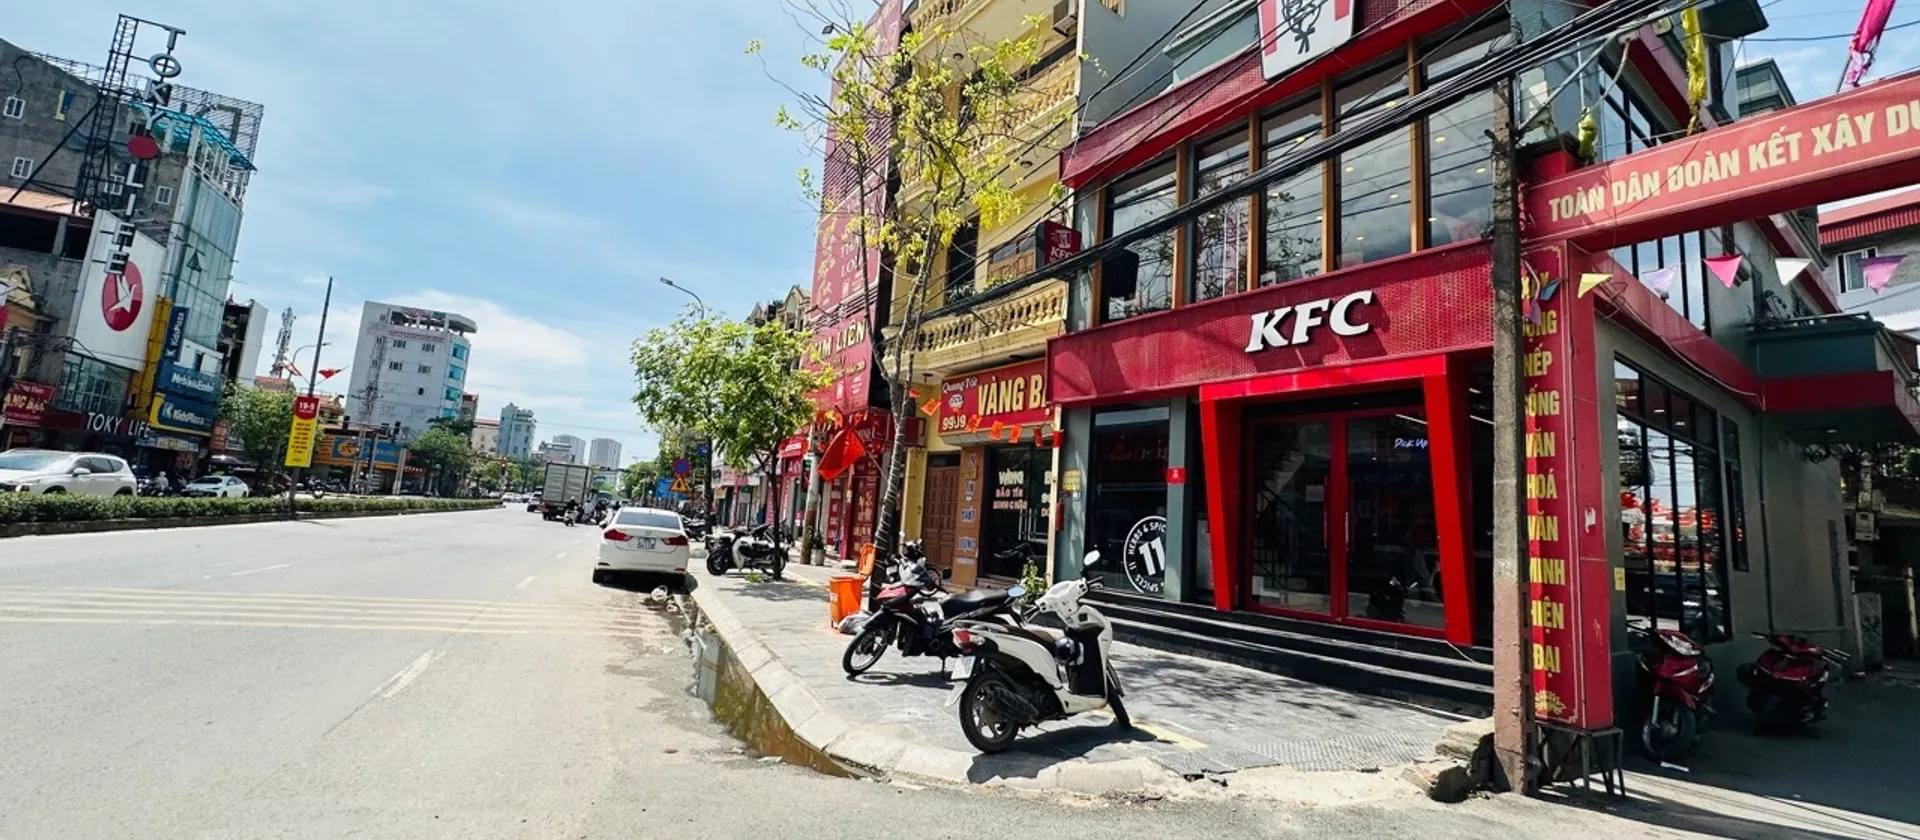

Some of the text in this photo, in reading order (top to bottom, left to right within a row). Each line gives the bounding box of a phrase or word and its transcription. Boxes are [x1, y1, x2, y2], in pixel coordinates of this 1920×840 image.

[1548, 185, 1606, 222] TOÀN
[1611, 171, 1661, 207] DÂN
[1667, 150, 1741, 193] ĐOÀN
[1749, 126, 1802, 172] KẾT
[1811, 113, 1876, 157] XÂY
[104, 163, 145, 274] LIFE
[1244, 290, 1373, 353] KFC
[978, 375, 1026, 417] VÀNG
[87, 411, 151, 438] TOKY LIFE
[1525, 427, 1556, 458] VĂN
[1527, 468, 1558, 500] HOÁ
[1527, 510, 1559, 541] VĂN
[1138, 536, 1166, 576] 11
